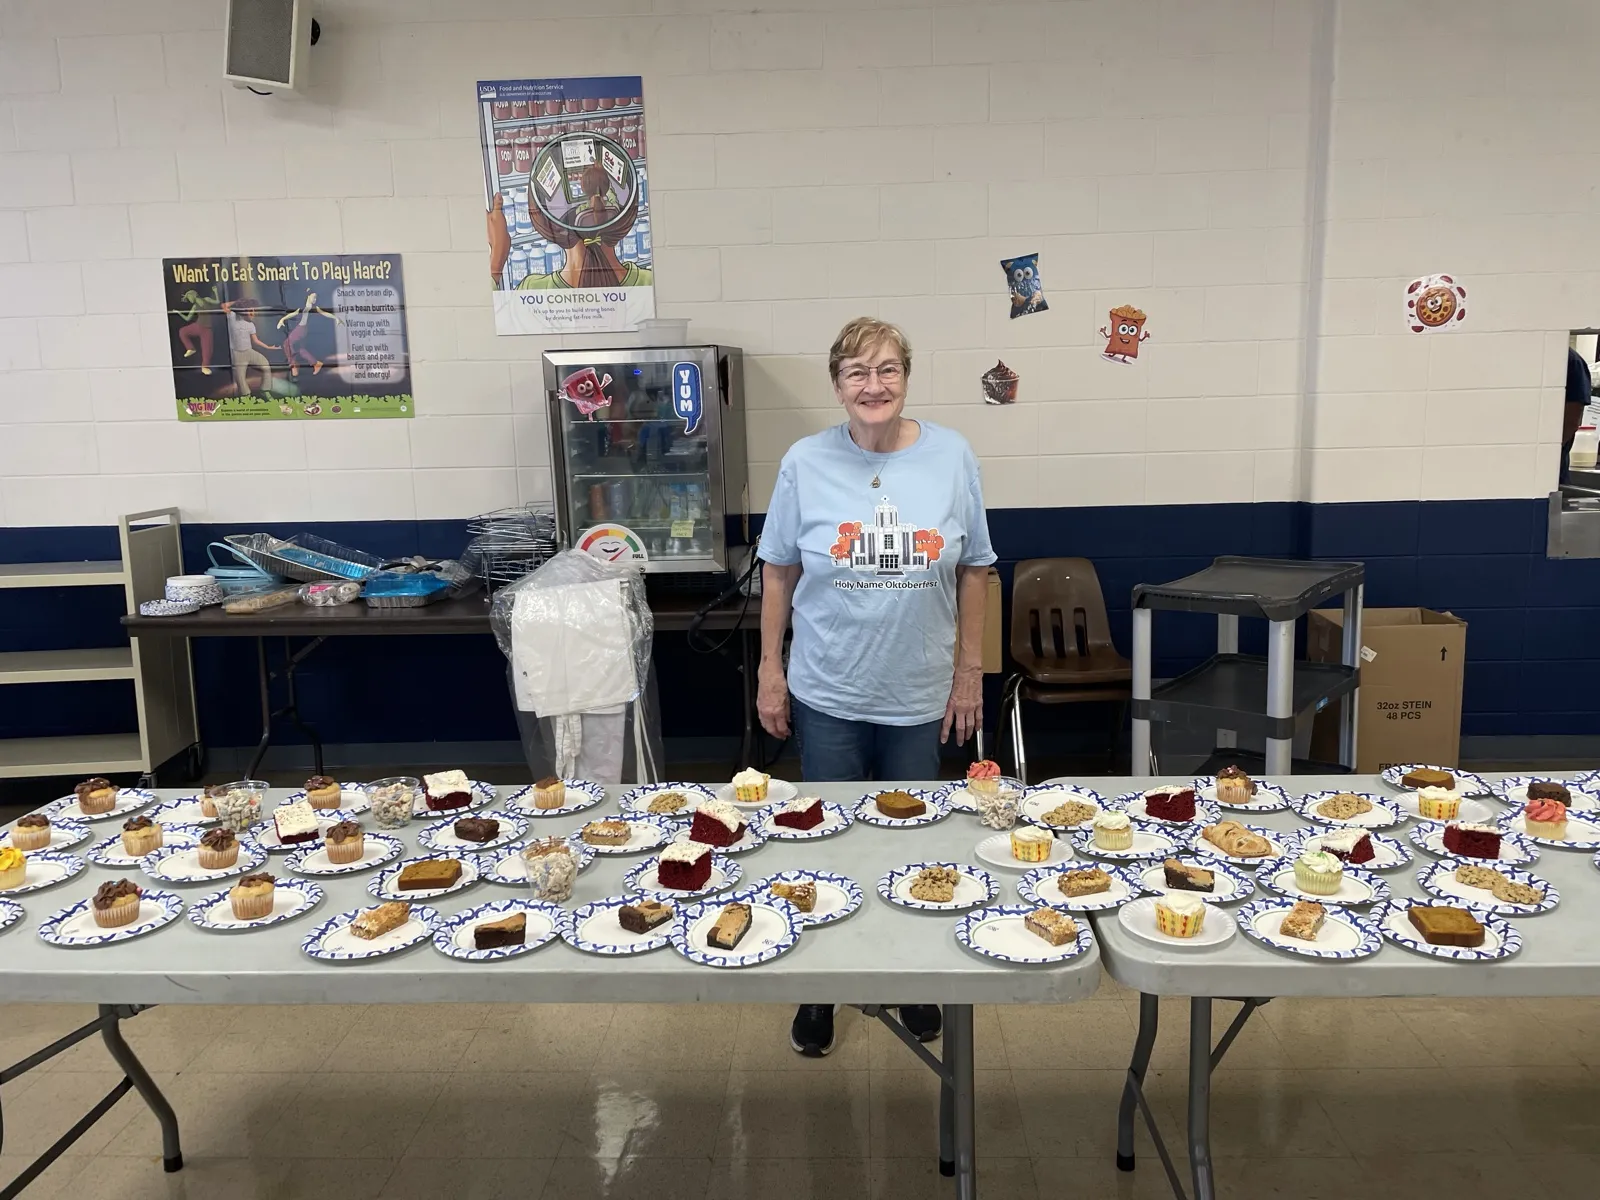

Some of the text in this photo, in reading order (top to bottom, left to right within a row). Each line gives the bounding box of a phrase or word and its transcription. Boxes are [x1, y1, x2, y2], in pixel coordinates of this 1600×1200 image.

[622, 138, 637, 149] SODA
[515, 150, 530, 160] SODA
[172, 260, 392, 285] Want To Eat Smart To Play Hard?
[337, 288, 356, 297] Snack
[366, 288, 382, 297] bean
[383, 288, 395, 298] dip.
[520, 293, 626, 305] YOU CONTROL YOU
[338, 304, 349, 314] Try
[355, 304, 371, 312] bean
[372, 304, 397, 312] burrito.
[552, 314, 573, 322] drinking
[346, 319, 390, 328] Warm up with
[351, 329, 372, 338] veggie
[365, 345, 374, 353] up
[375, 343, 388, 351] with
[347, 353, 395, 362] beans and peas
[366, 362, 389, 370] protein
[367, 370, 391, 380] energy!
[679, 369, 693, 412] YUM
[189, 402, 203, 411] DIG
[203, 402, 217, 411] IN!
[835, 580, 938, 590] Holy Name Oktoberfest
[1377, 701, 1432, 710] 32oz STEIN
[1386, 712, 1397, 720] 48
